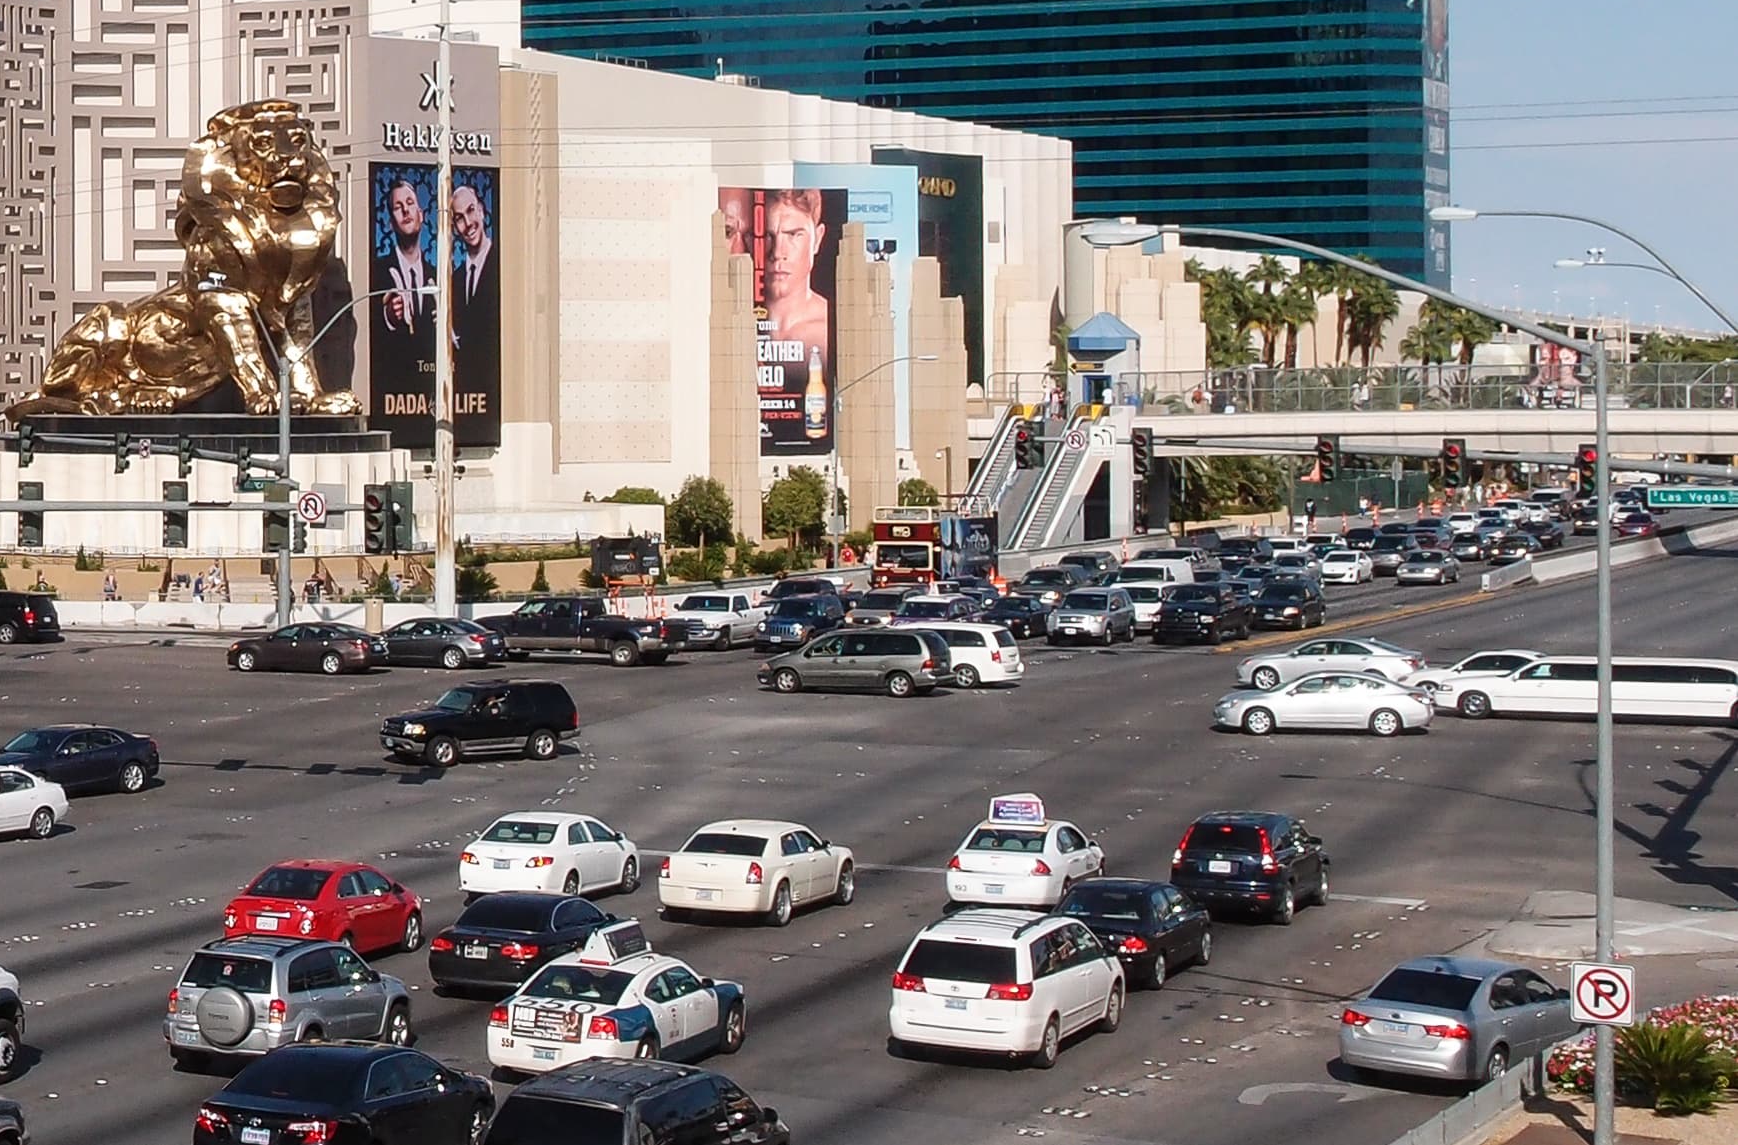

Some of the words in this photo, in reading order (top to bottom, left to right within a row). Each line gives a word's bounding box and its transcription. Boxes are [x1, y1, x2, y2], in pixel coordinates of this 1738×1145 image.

[757, 340, 804, 362] EATHER
[385, 393, 427, 415] DADA
[455, 393, 486, 414] LIFE
[1660, 491, 1681, 502] Las
[1689, 492, 1727, 504] Vegas
